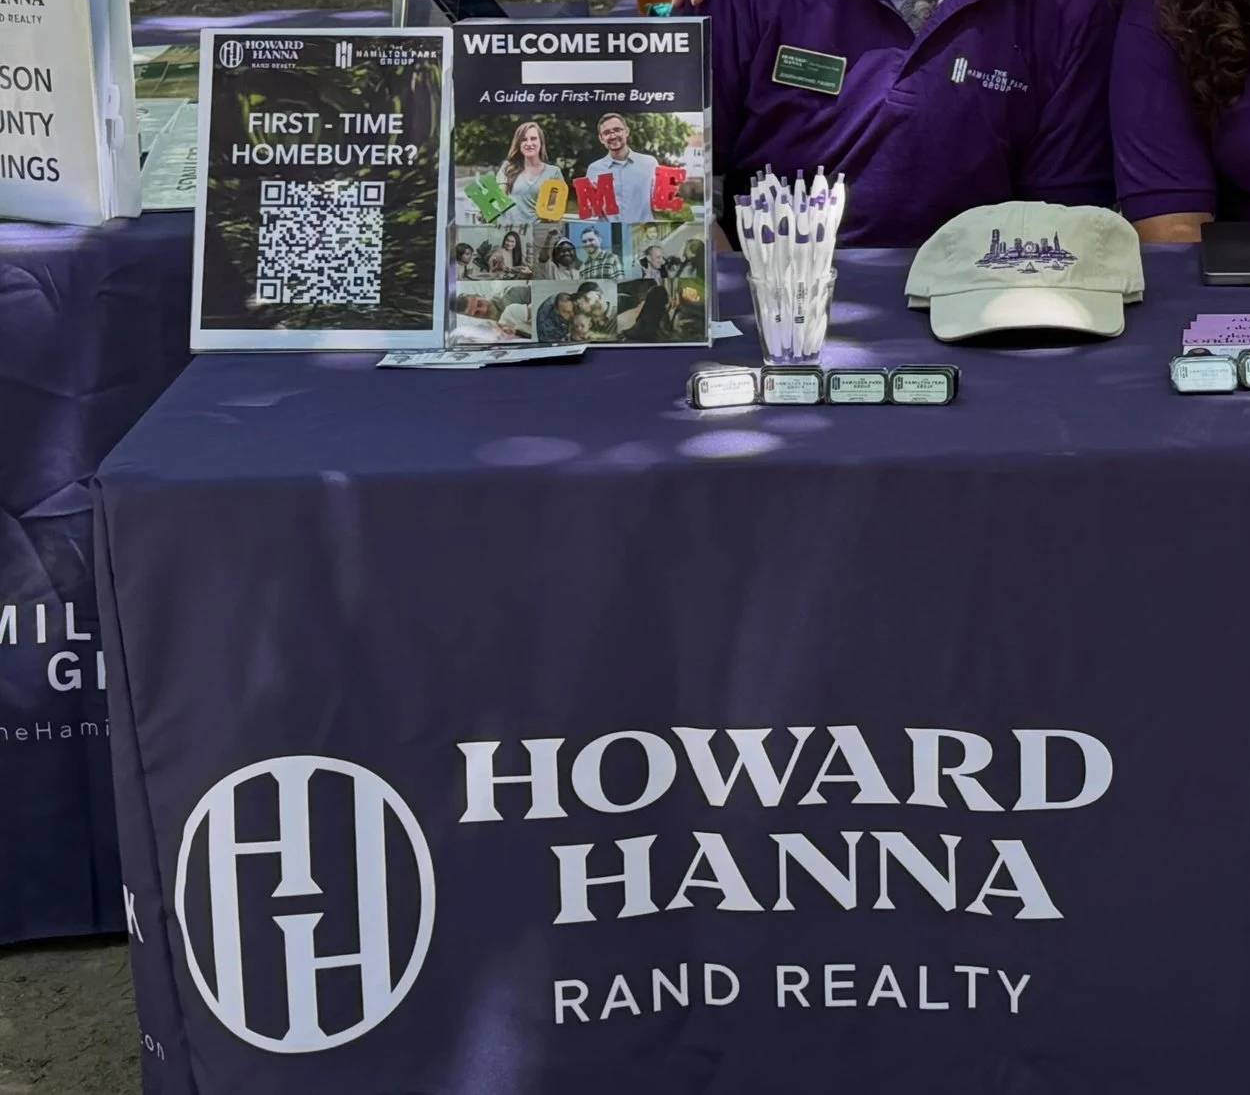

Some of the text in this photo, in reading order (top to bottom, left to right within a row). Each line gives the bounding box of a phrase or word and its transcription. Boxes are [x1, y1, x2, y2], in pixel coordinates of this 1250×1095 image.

[8, 14, 42, 24] REALTY
[244, 40, 304, 50] HOWARD
[463, 32, 690, 55] WELCOME HOME
[252, 50, 299, 60] HANNA
[355, 50, 437, 58] HAMILTON PARK
[967, 69, 1008, 85] HAMILTON
[982, 80, 1012, 93] GROUP
[480, 89, 675, 104] A Guide for First-Time Buyers
[249, 113, 320, 134] FIRST
[339, 113, 404, 134] TIME
[232, 143, 418, 166] HOMEBUYER?
[457, 725, 1113, 823] HOWARD
[550, 831, 1064, 924] HANNA
[554, 962, 1032, 1024] RAND REALTY
